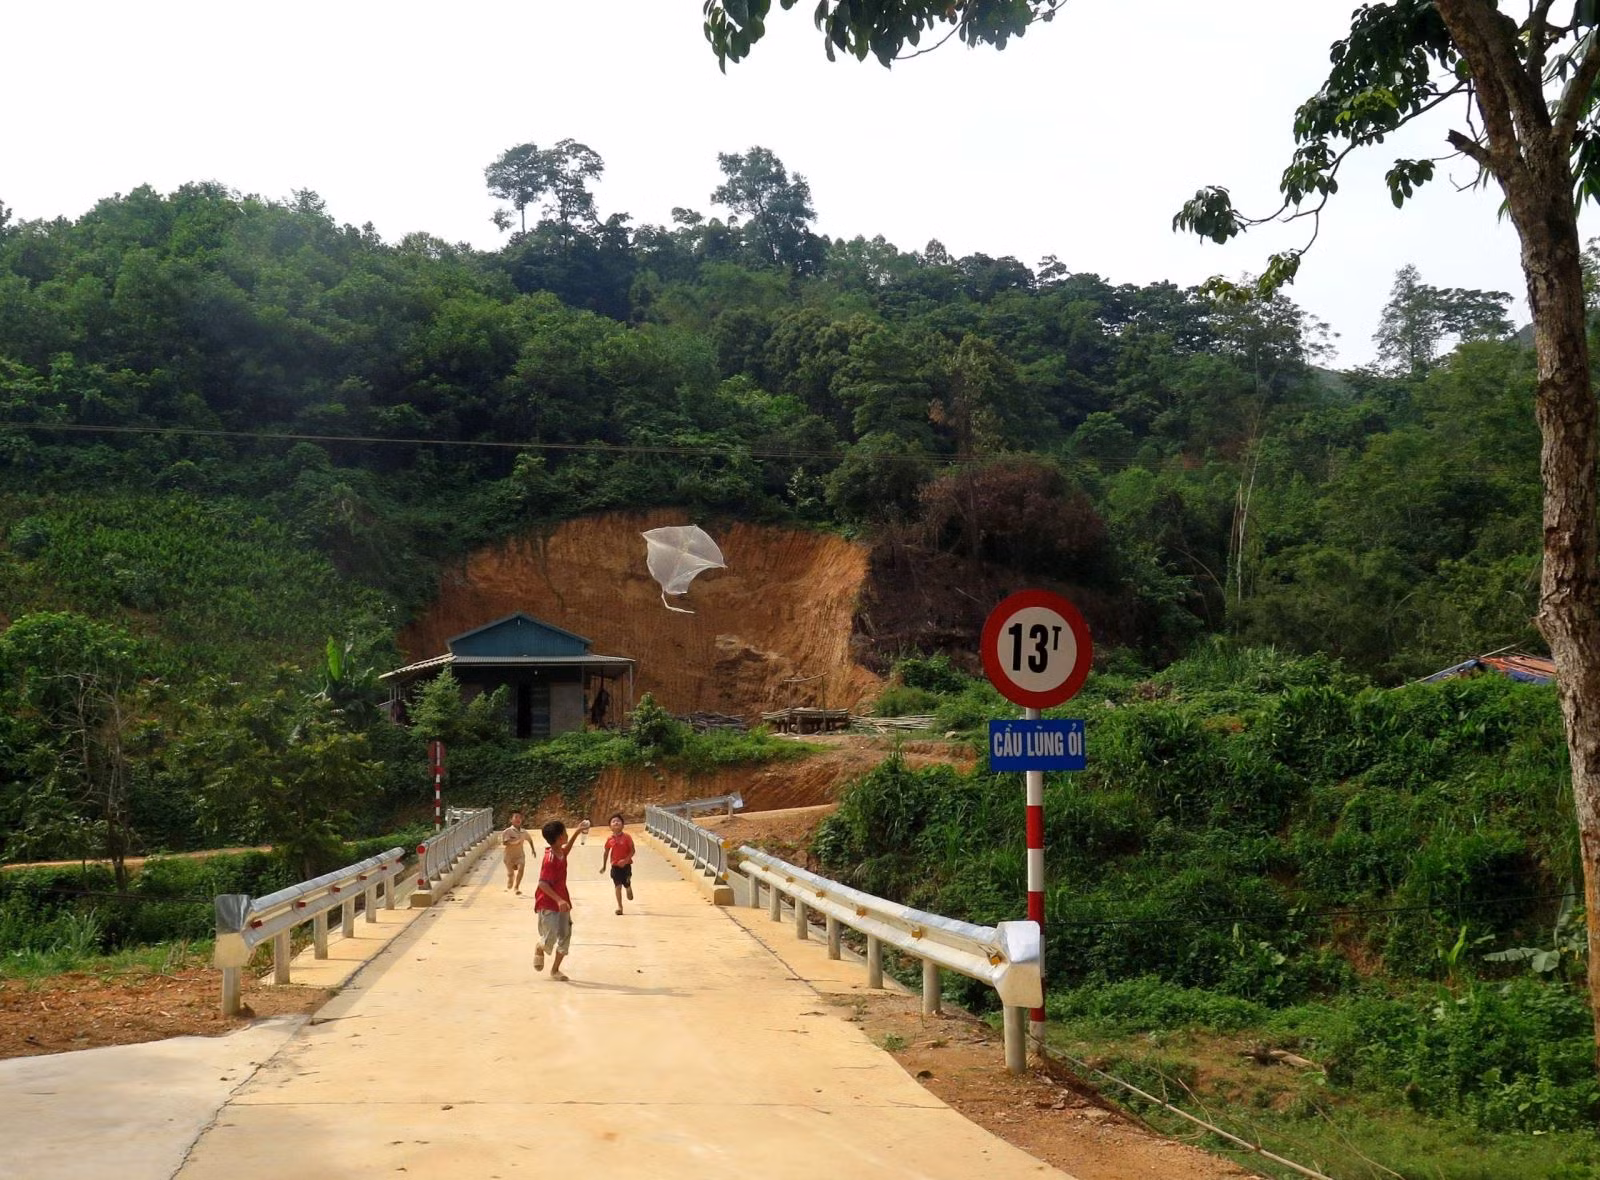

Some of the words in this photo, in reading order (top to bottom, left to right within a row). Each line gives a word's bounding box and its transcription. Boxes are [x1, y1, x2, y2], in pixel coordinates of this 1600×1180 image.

[993, 723, 1023, 757] CẦU
[1026, 725, 1064, 756] LŨNG
[1068, 722, 1082, 756] ỎI
